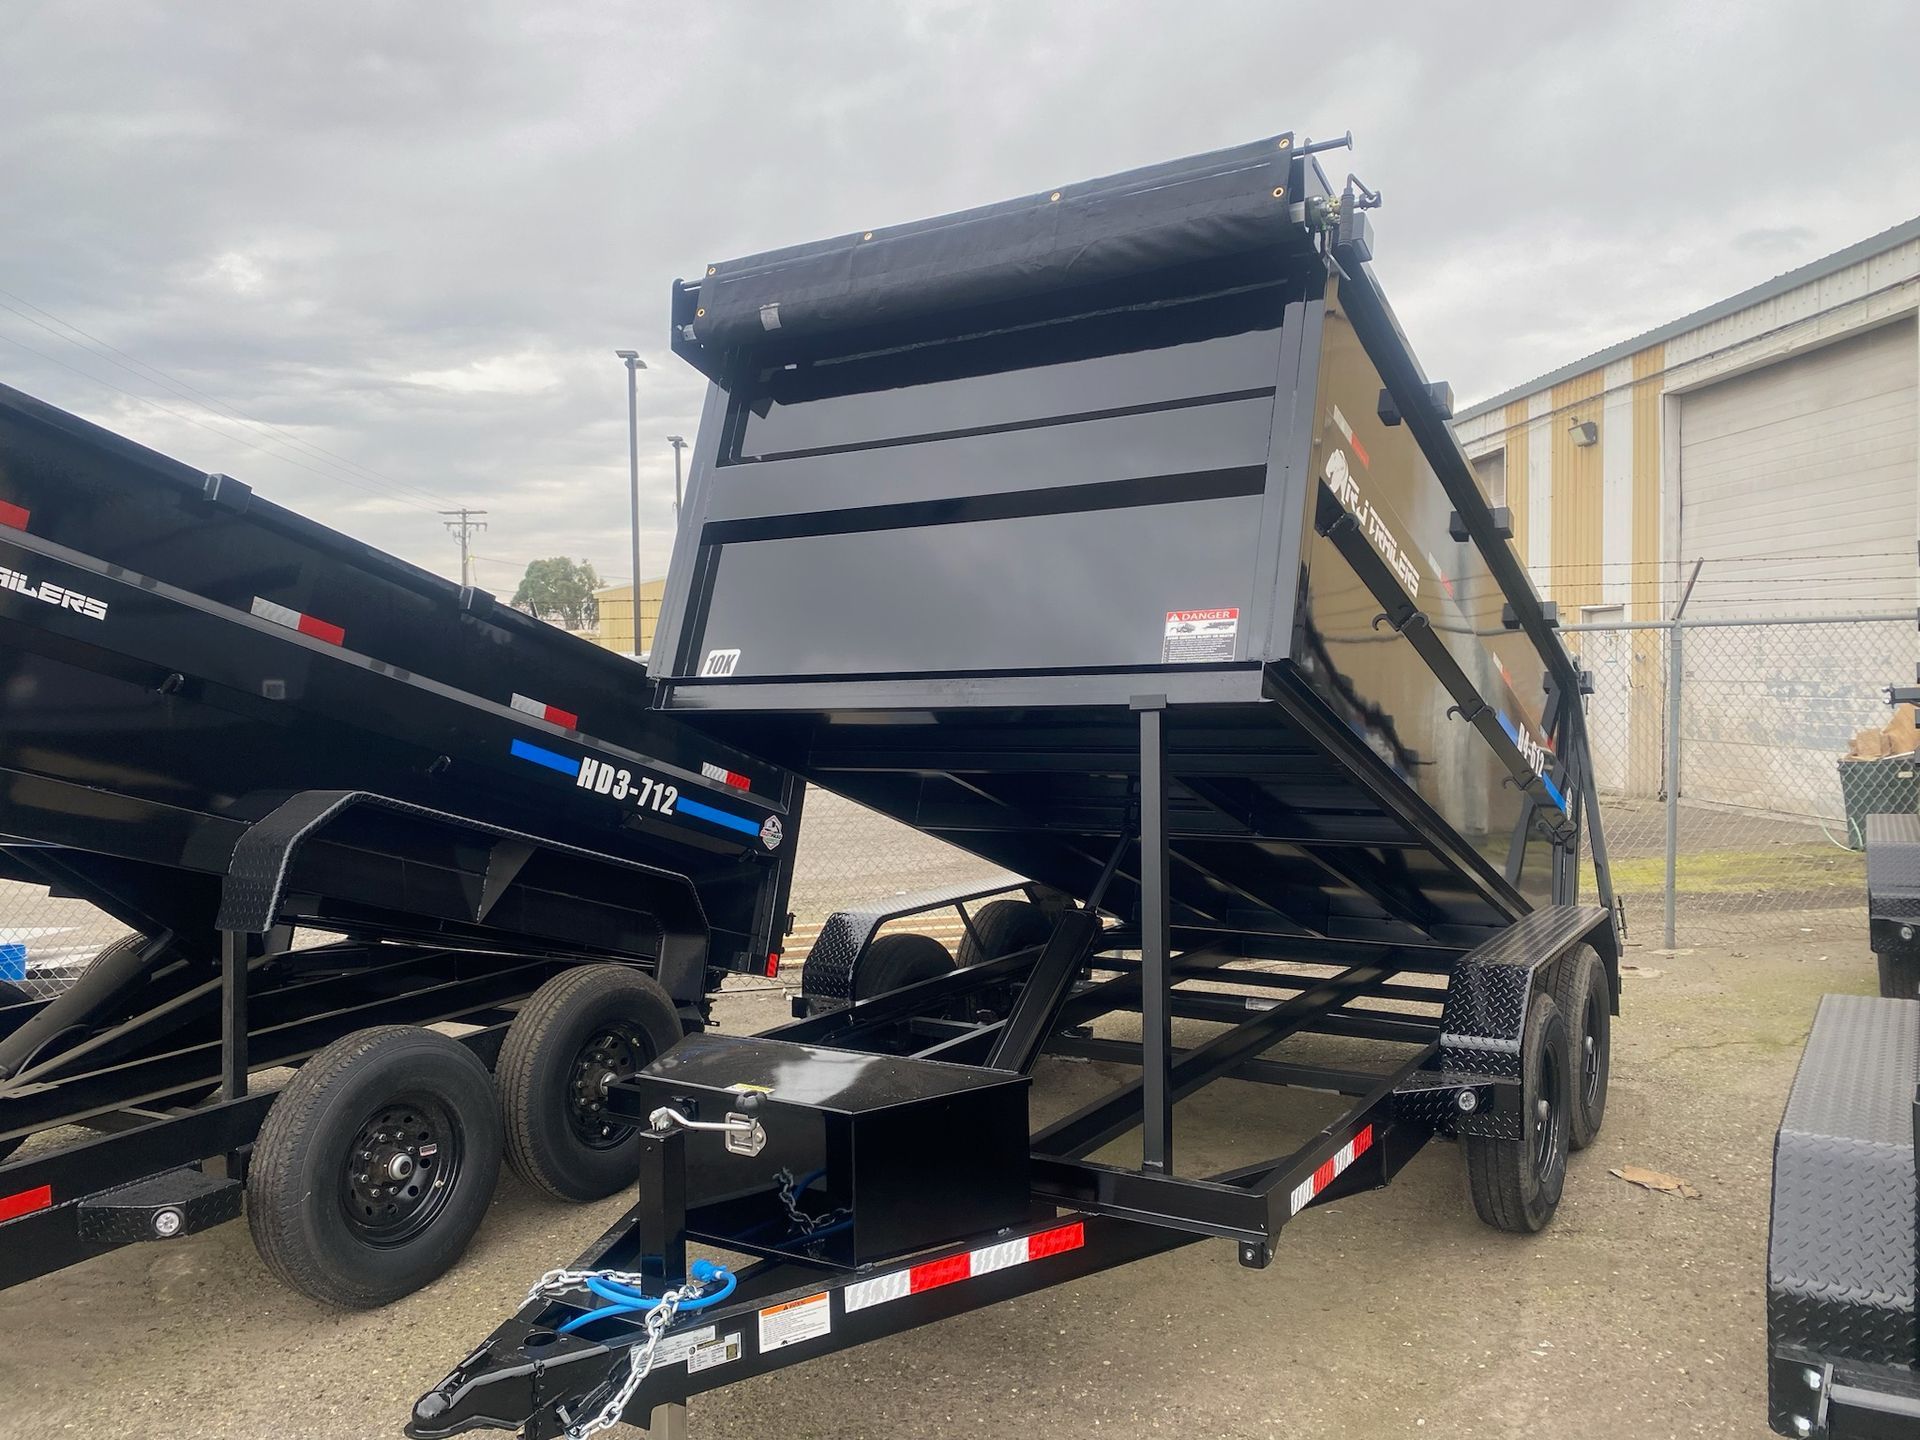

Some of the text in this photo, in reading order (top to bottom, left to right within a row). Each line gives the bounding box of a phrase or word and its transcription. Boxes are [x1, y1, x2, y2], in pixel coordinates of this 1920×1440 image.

[1369, 506, 1420, 598] TRAILERS
[1181, 611, 1230, 621] DANGER
[706, 654, 737, 675] 10K
[576, 756, 679, 816] HD3-712
